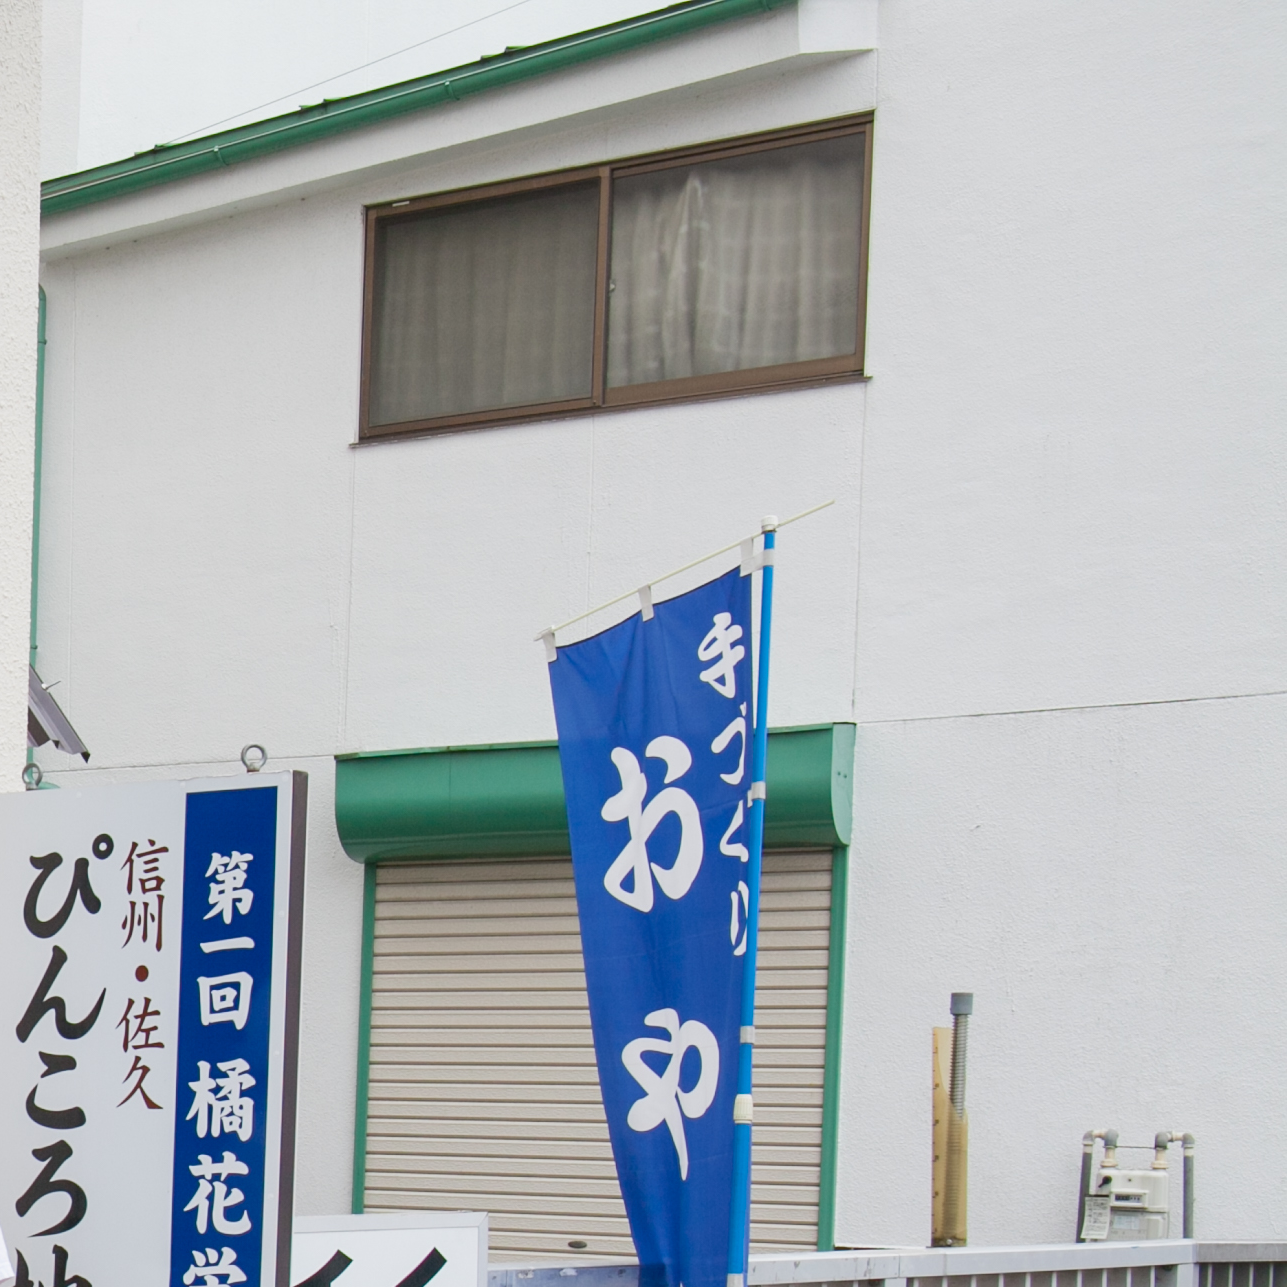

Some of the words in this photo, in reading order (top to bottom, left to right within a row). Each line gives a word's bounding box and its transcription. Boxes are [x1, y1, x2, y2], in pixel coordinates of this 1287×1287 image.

[698, 612, 750, 956] 手づくり
[115, 839, 170, 1110] 信州・佐久
